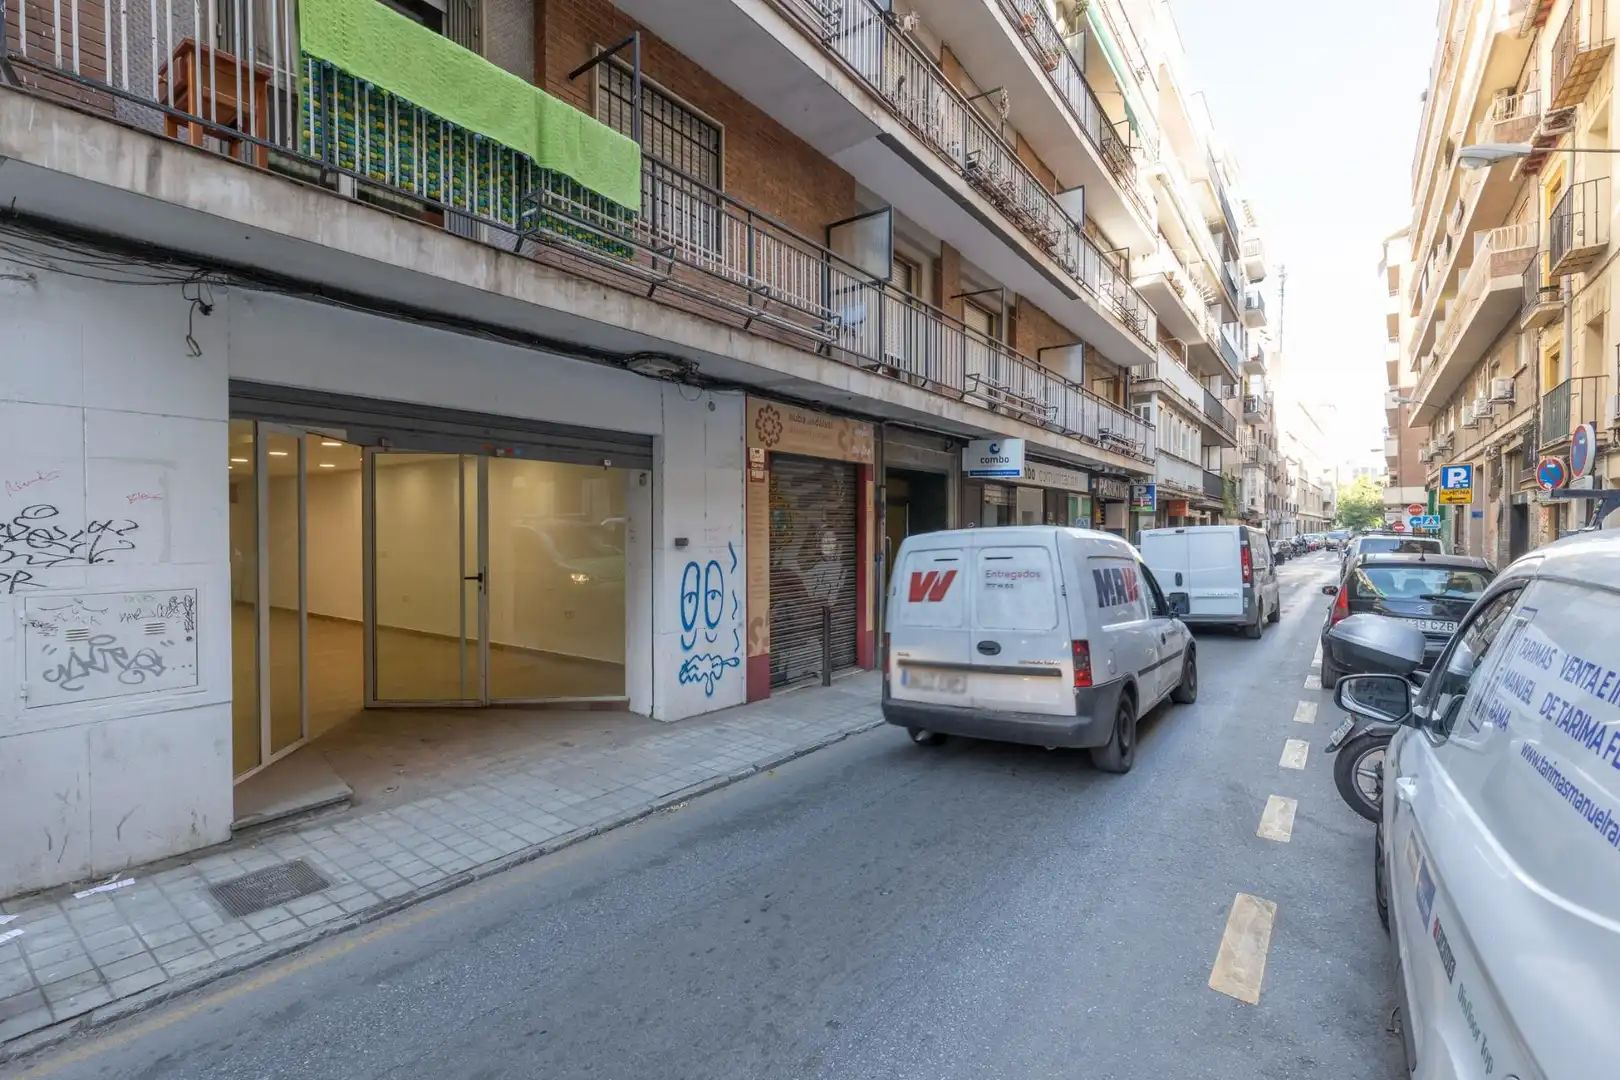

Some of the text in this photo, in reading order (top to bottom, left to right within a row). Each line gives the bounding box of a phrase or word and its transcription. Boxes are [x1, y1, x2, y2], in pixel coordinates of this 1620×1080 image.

[980, 455, 1010, 464] combo
[1099, 478, 1129, 499] PARKING
[1447, 467, 1468, 488] P
[1430, 621, 1455, 631] CZB
[1518, 638, 1558, 670] TARIMAS
[1502, 669, 1536, 706] MANUEL
[1559, 654, 1602, 694] VENTA
[1596, 670, 1617, 699] E
[1539, 692, 1561, 721] DE
[1554, 700, 1608, 755] TARIMA
[1480, 1031, 1494, 1076] Top
